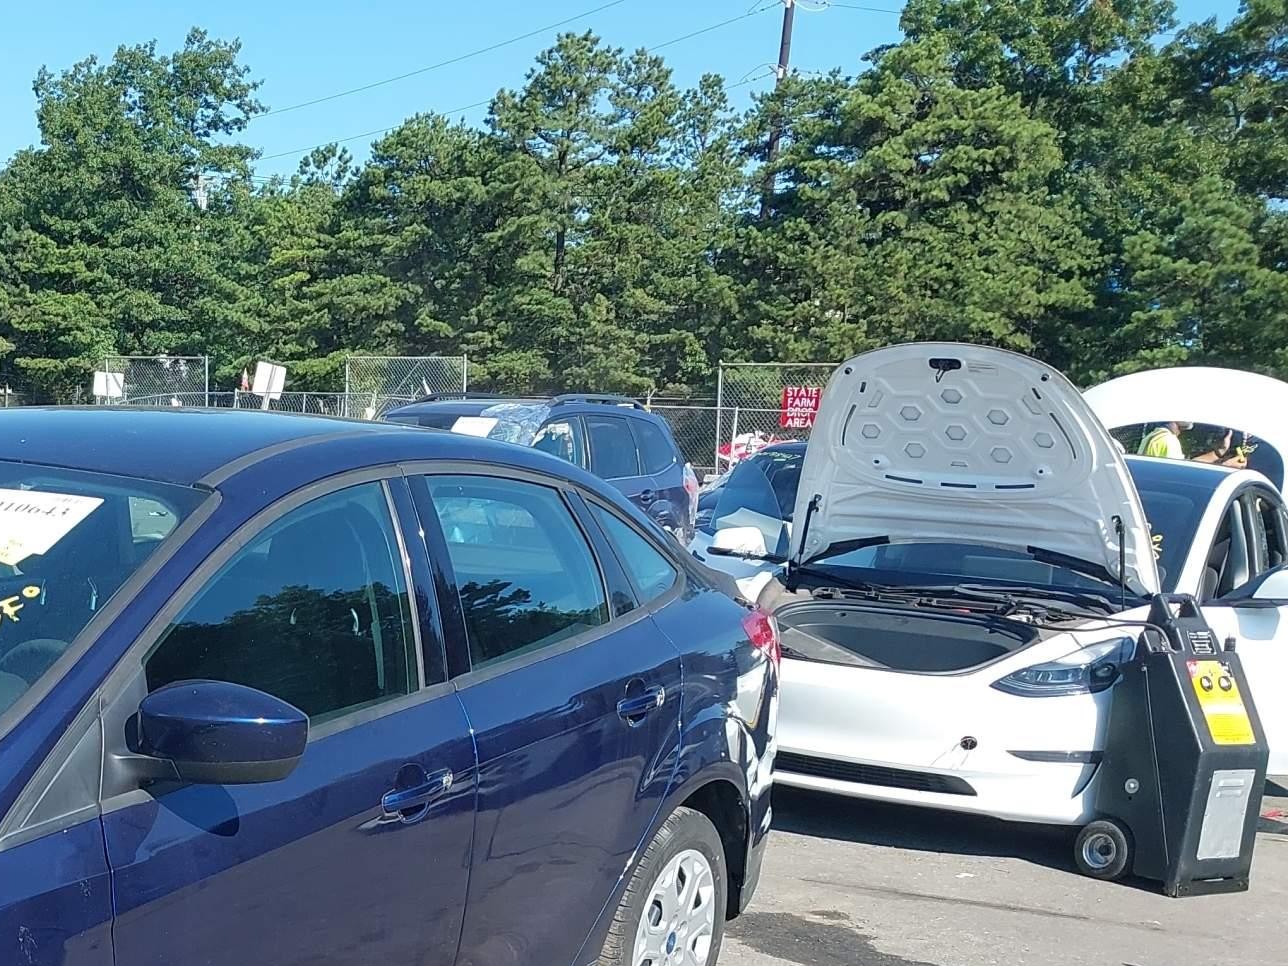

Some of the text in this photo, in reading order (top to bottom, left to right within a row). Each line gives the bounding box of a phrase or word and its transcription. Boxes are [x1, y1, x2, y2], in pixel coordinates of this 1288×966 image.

[787, 387, 818, 397] STATE
[787, 398, 816, 407] FARM
[786, 407, 813, 417] DROP
[785, 418, 812, 428] AREA
